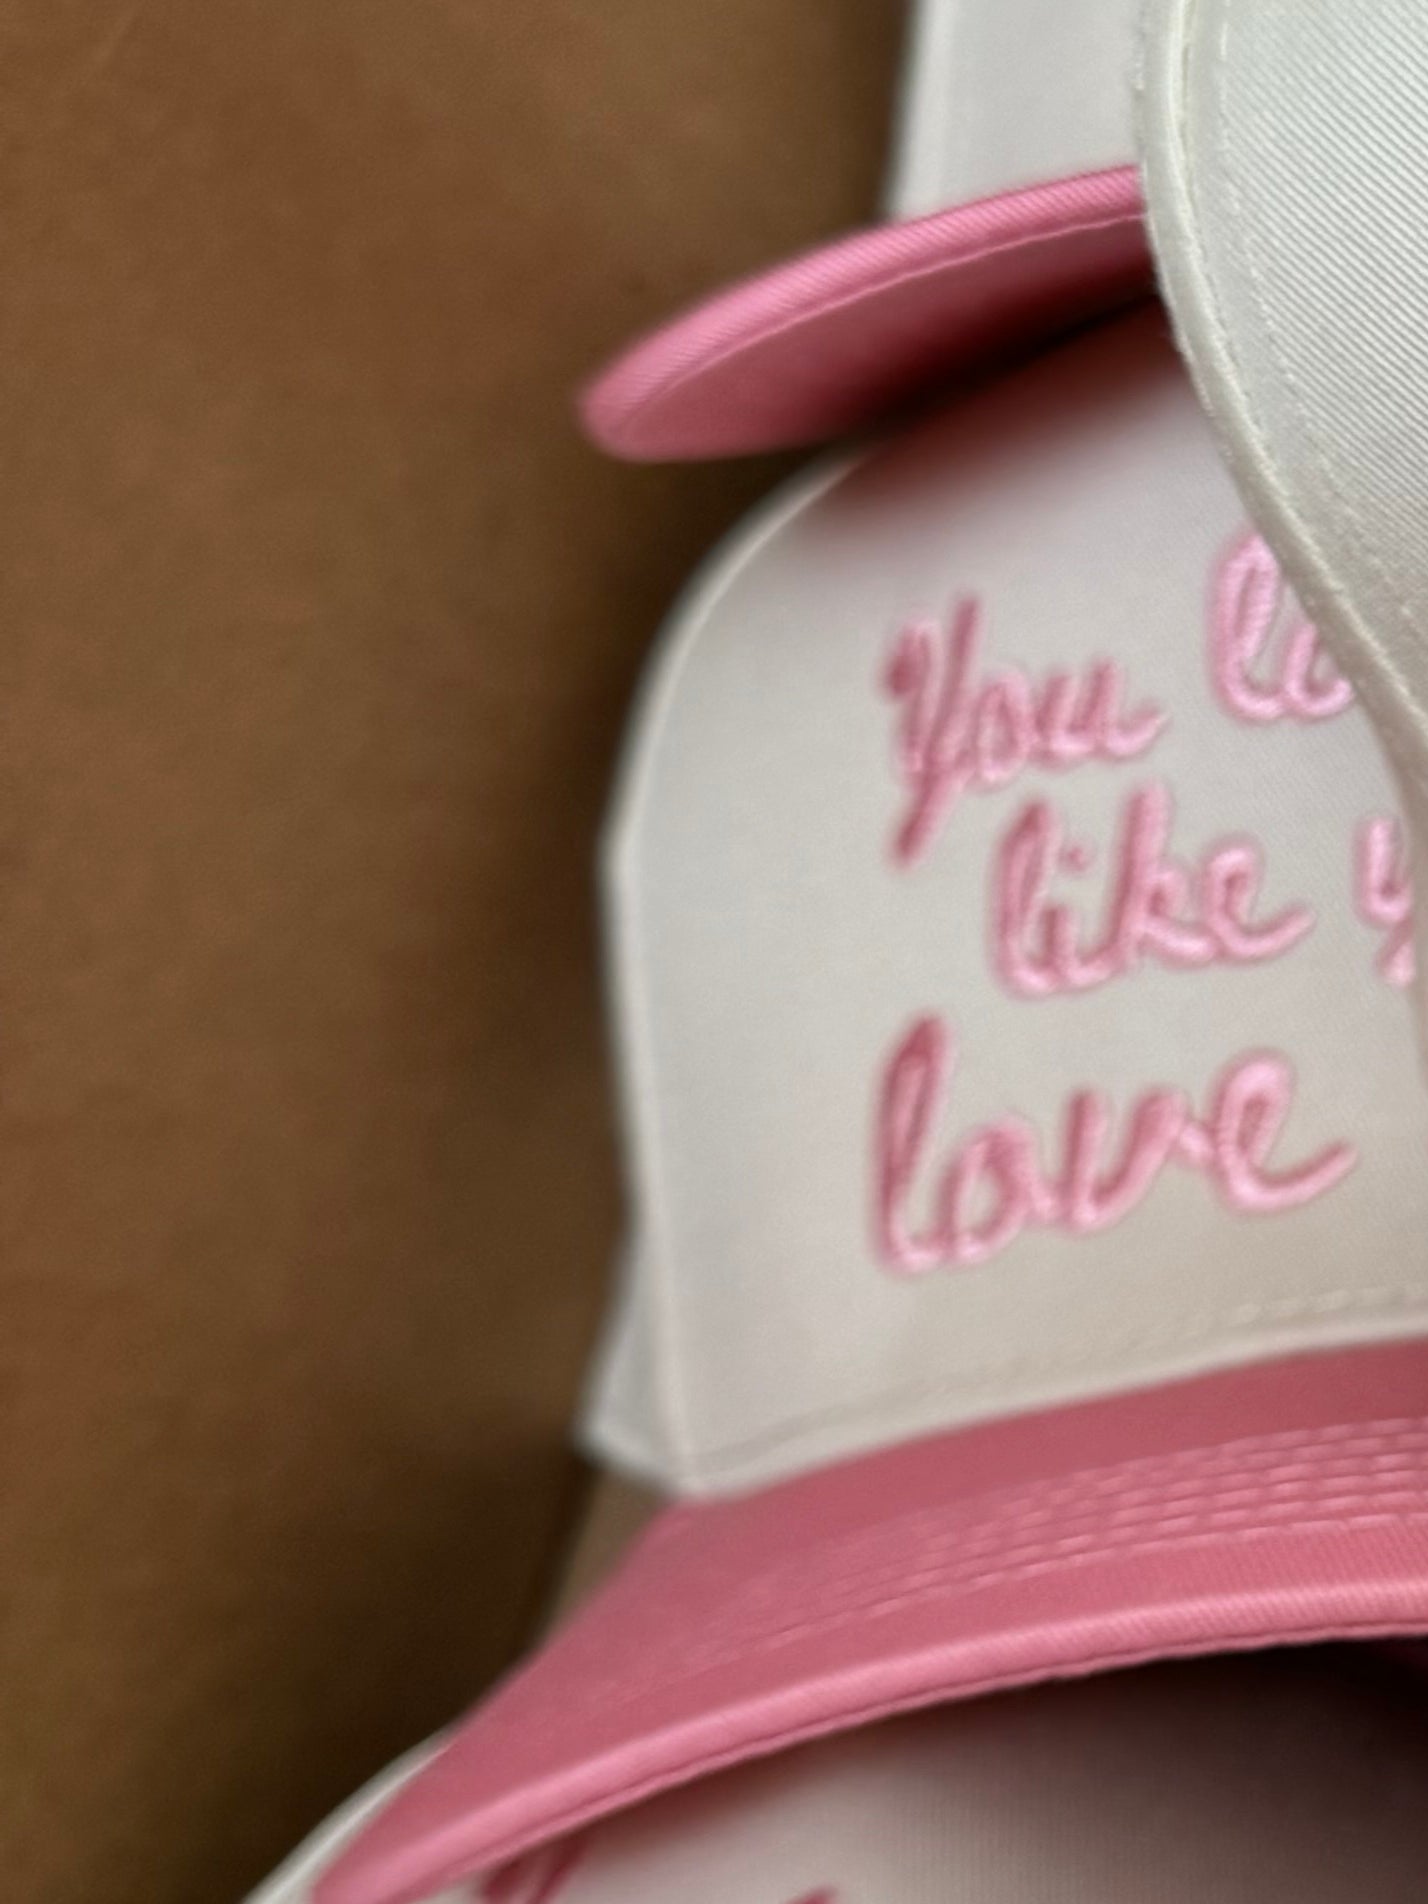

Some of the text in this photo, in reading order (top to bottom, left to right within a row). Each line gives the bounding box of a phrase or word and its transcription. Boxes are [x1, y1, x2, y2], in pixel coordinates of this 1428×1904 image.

[876, 592, 1166, 870] You
[986, 780, 1314, 999] like
[869, 1011, 1357, 1276] love
